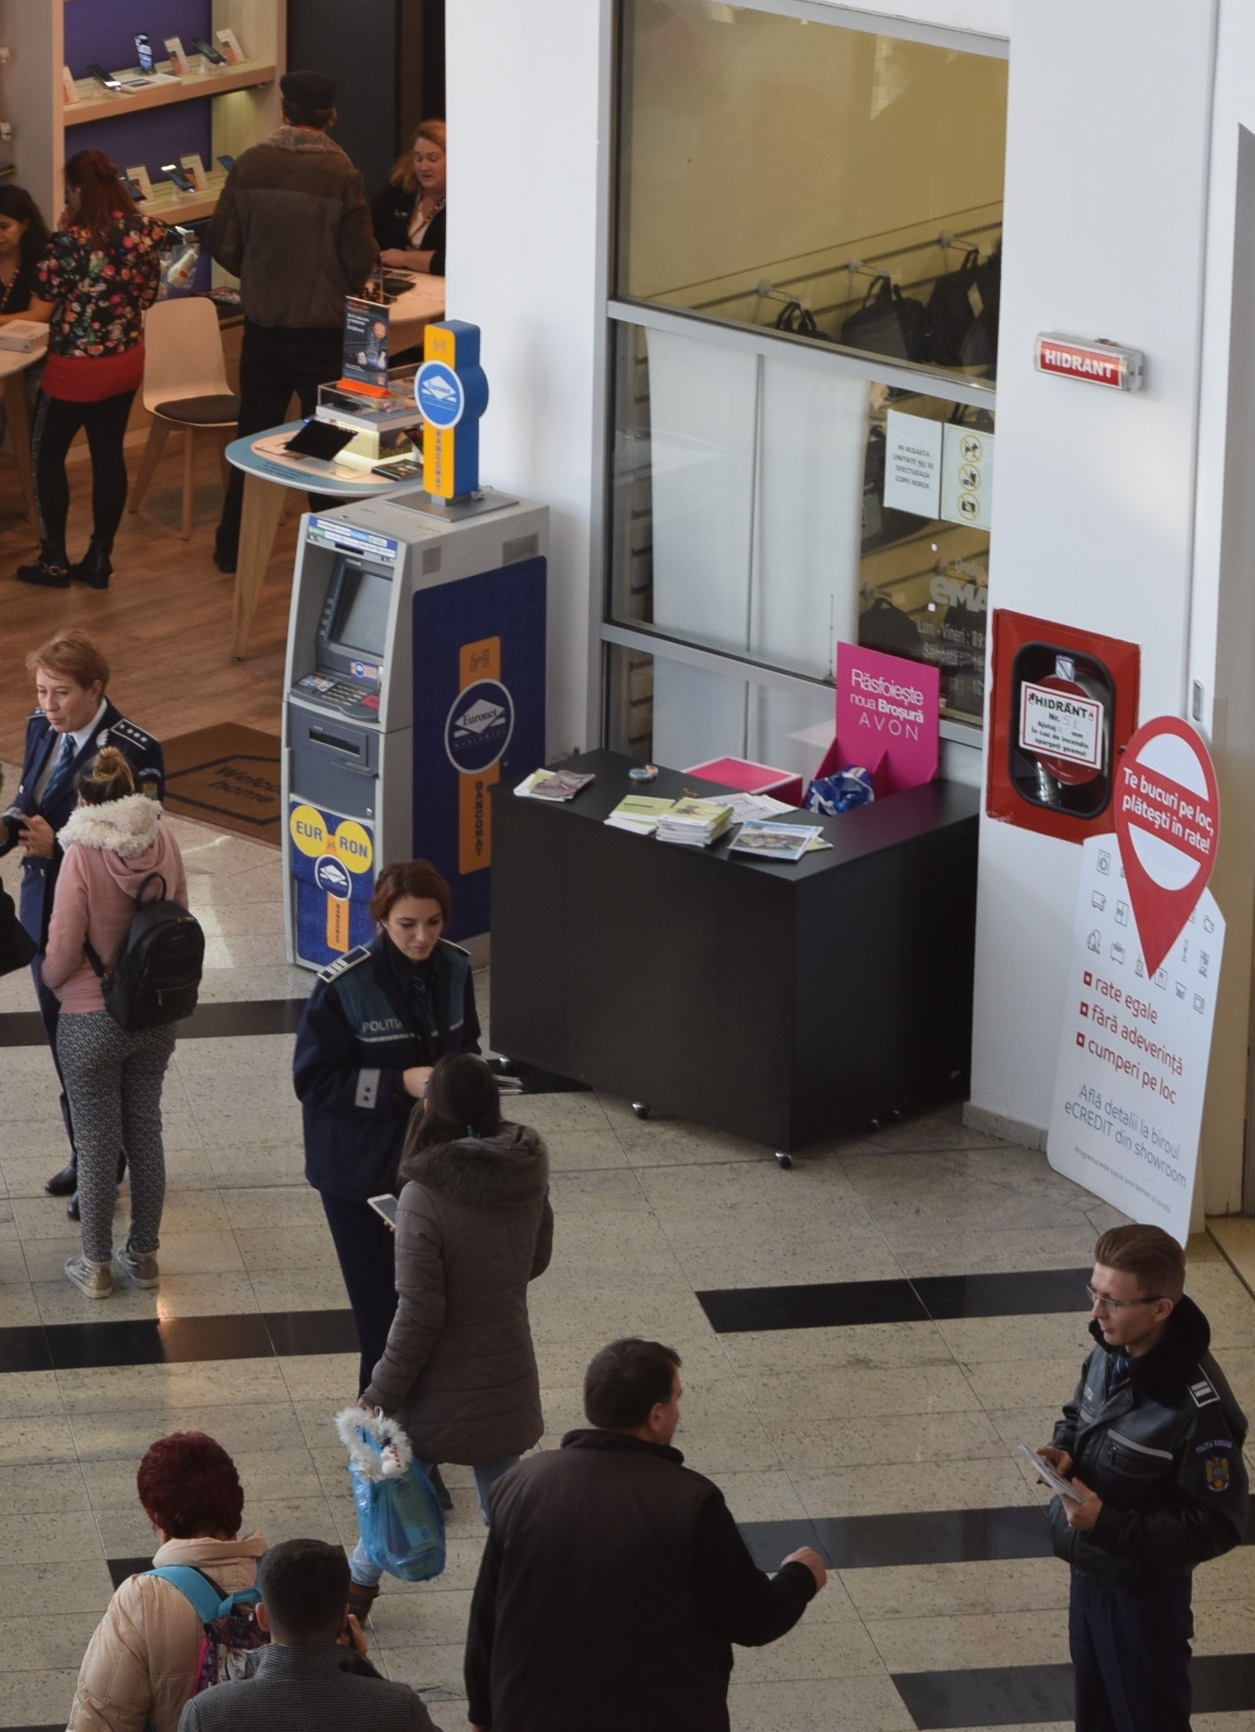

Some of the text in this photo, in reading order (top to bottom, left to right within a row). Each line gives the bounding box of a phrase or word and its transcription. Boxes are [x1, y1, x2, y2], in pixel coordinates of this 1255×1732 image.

[1044, 348, 1115, 378] HIDRANT
[929, 575, 988, 613] eMA
[462, 708, 499, 728] Euronet
[849, 692, 877, 711] noua
[858, 711, 919, 742] AVON
[214, 765, 282, 794] Welco
[475, 780, 484, 857] BANCOMAT
[1123, 766, 1215, 837] Te bucuri pe loc,
[295, 820, 368, 858] EUR RON
[1171, 815, 1183, 838] în
[1183, 828, 1211, 855] rate!
[1095, 977, 1158, 1025] rate egale
[1091, 1003, 1184, 1077] fără adeverință
[1087, 1039, 1177, 1106] cumperi pe loc
[1078, 1084, 1181, 1161] Află detalii la biroul
[1064, 1101, 1187, 1189] eCREDIT din showroom
